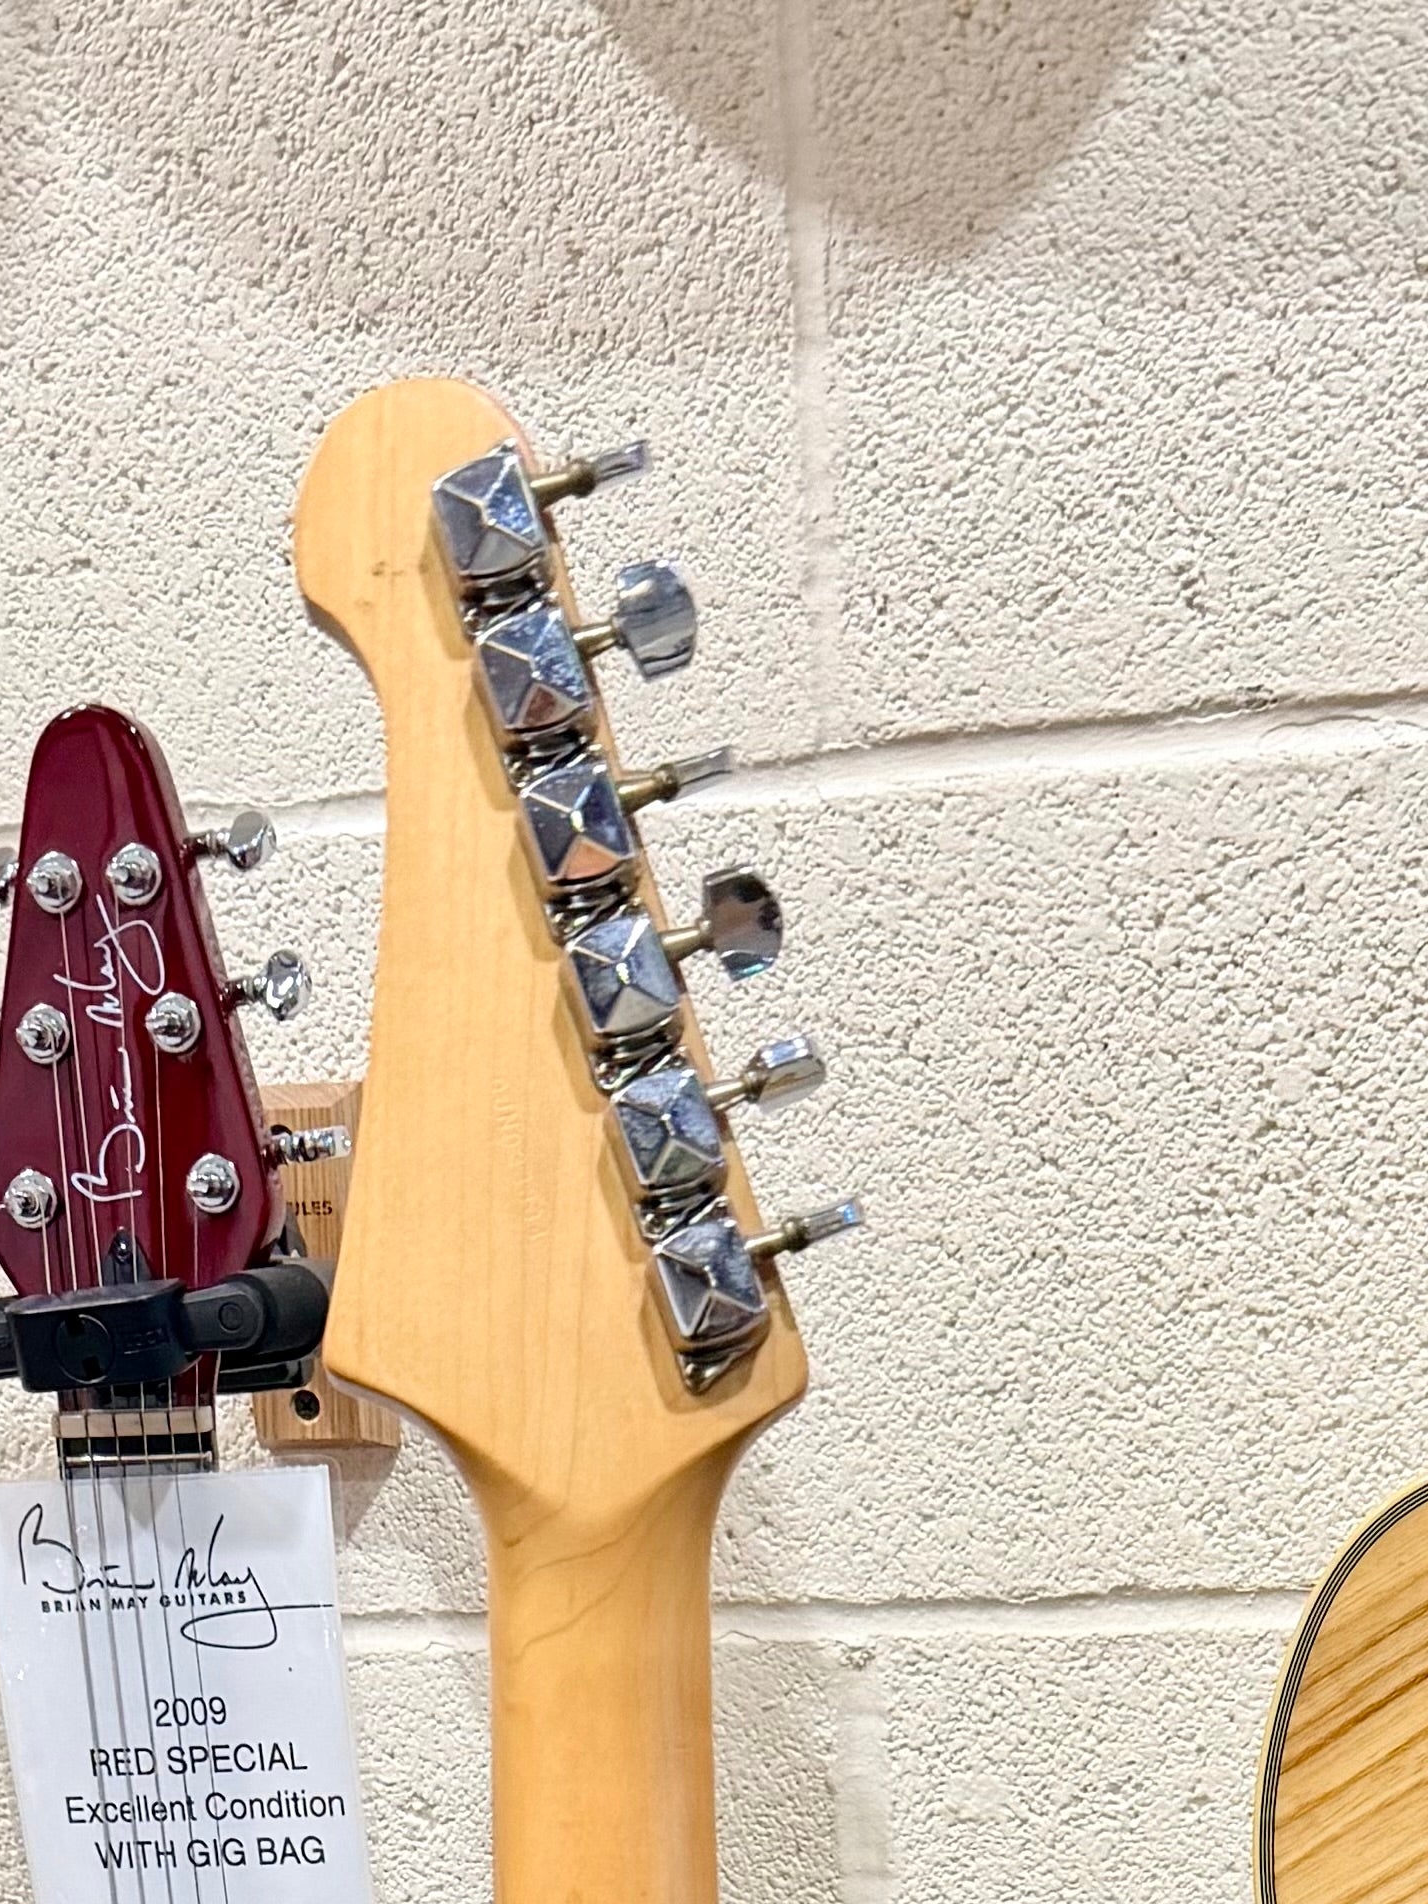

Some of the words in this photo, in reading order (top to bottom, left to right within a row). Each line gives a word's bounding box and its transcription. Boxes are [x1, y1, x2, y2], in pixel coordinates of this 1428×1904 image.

[41, 1598, 101, 1613] BRIAN
[112, 1596, 148, 1610] MAY
[160, 1591, 246, 1608] GUITARS
[154, 1696, 227, 1727] 2009
[89, 1747, 156, 1777] RED
[167, 1742, 308, 1775] SPECIAL
[65, 1795, 197, 1824] Excellent
[205, 1789, 346, 1820] Condition
[94, 1839, 177, 1869] WITH
[186, 1838, 246, 1868] GIG
[256, 1835, 325, 1865] BAG
